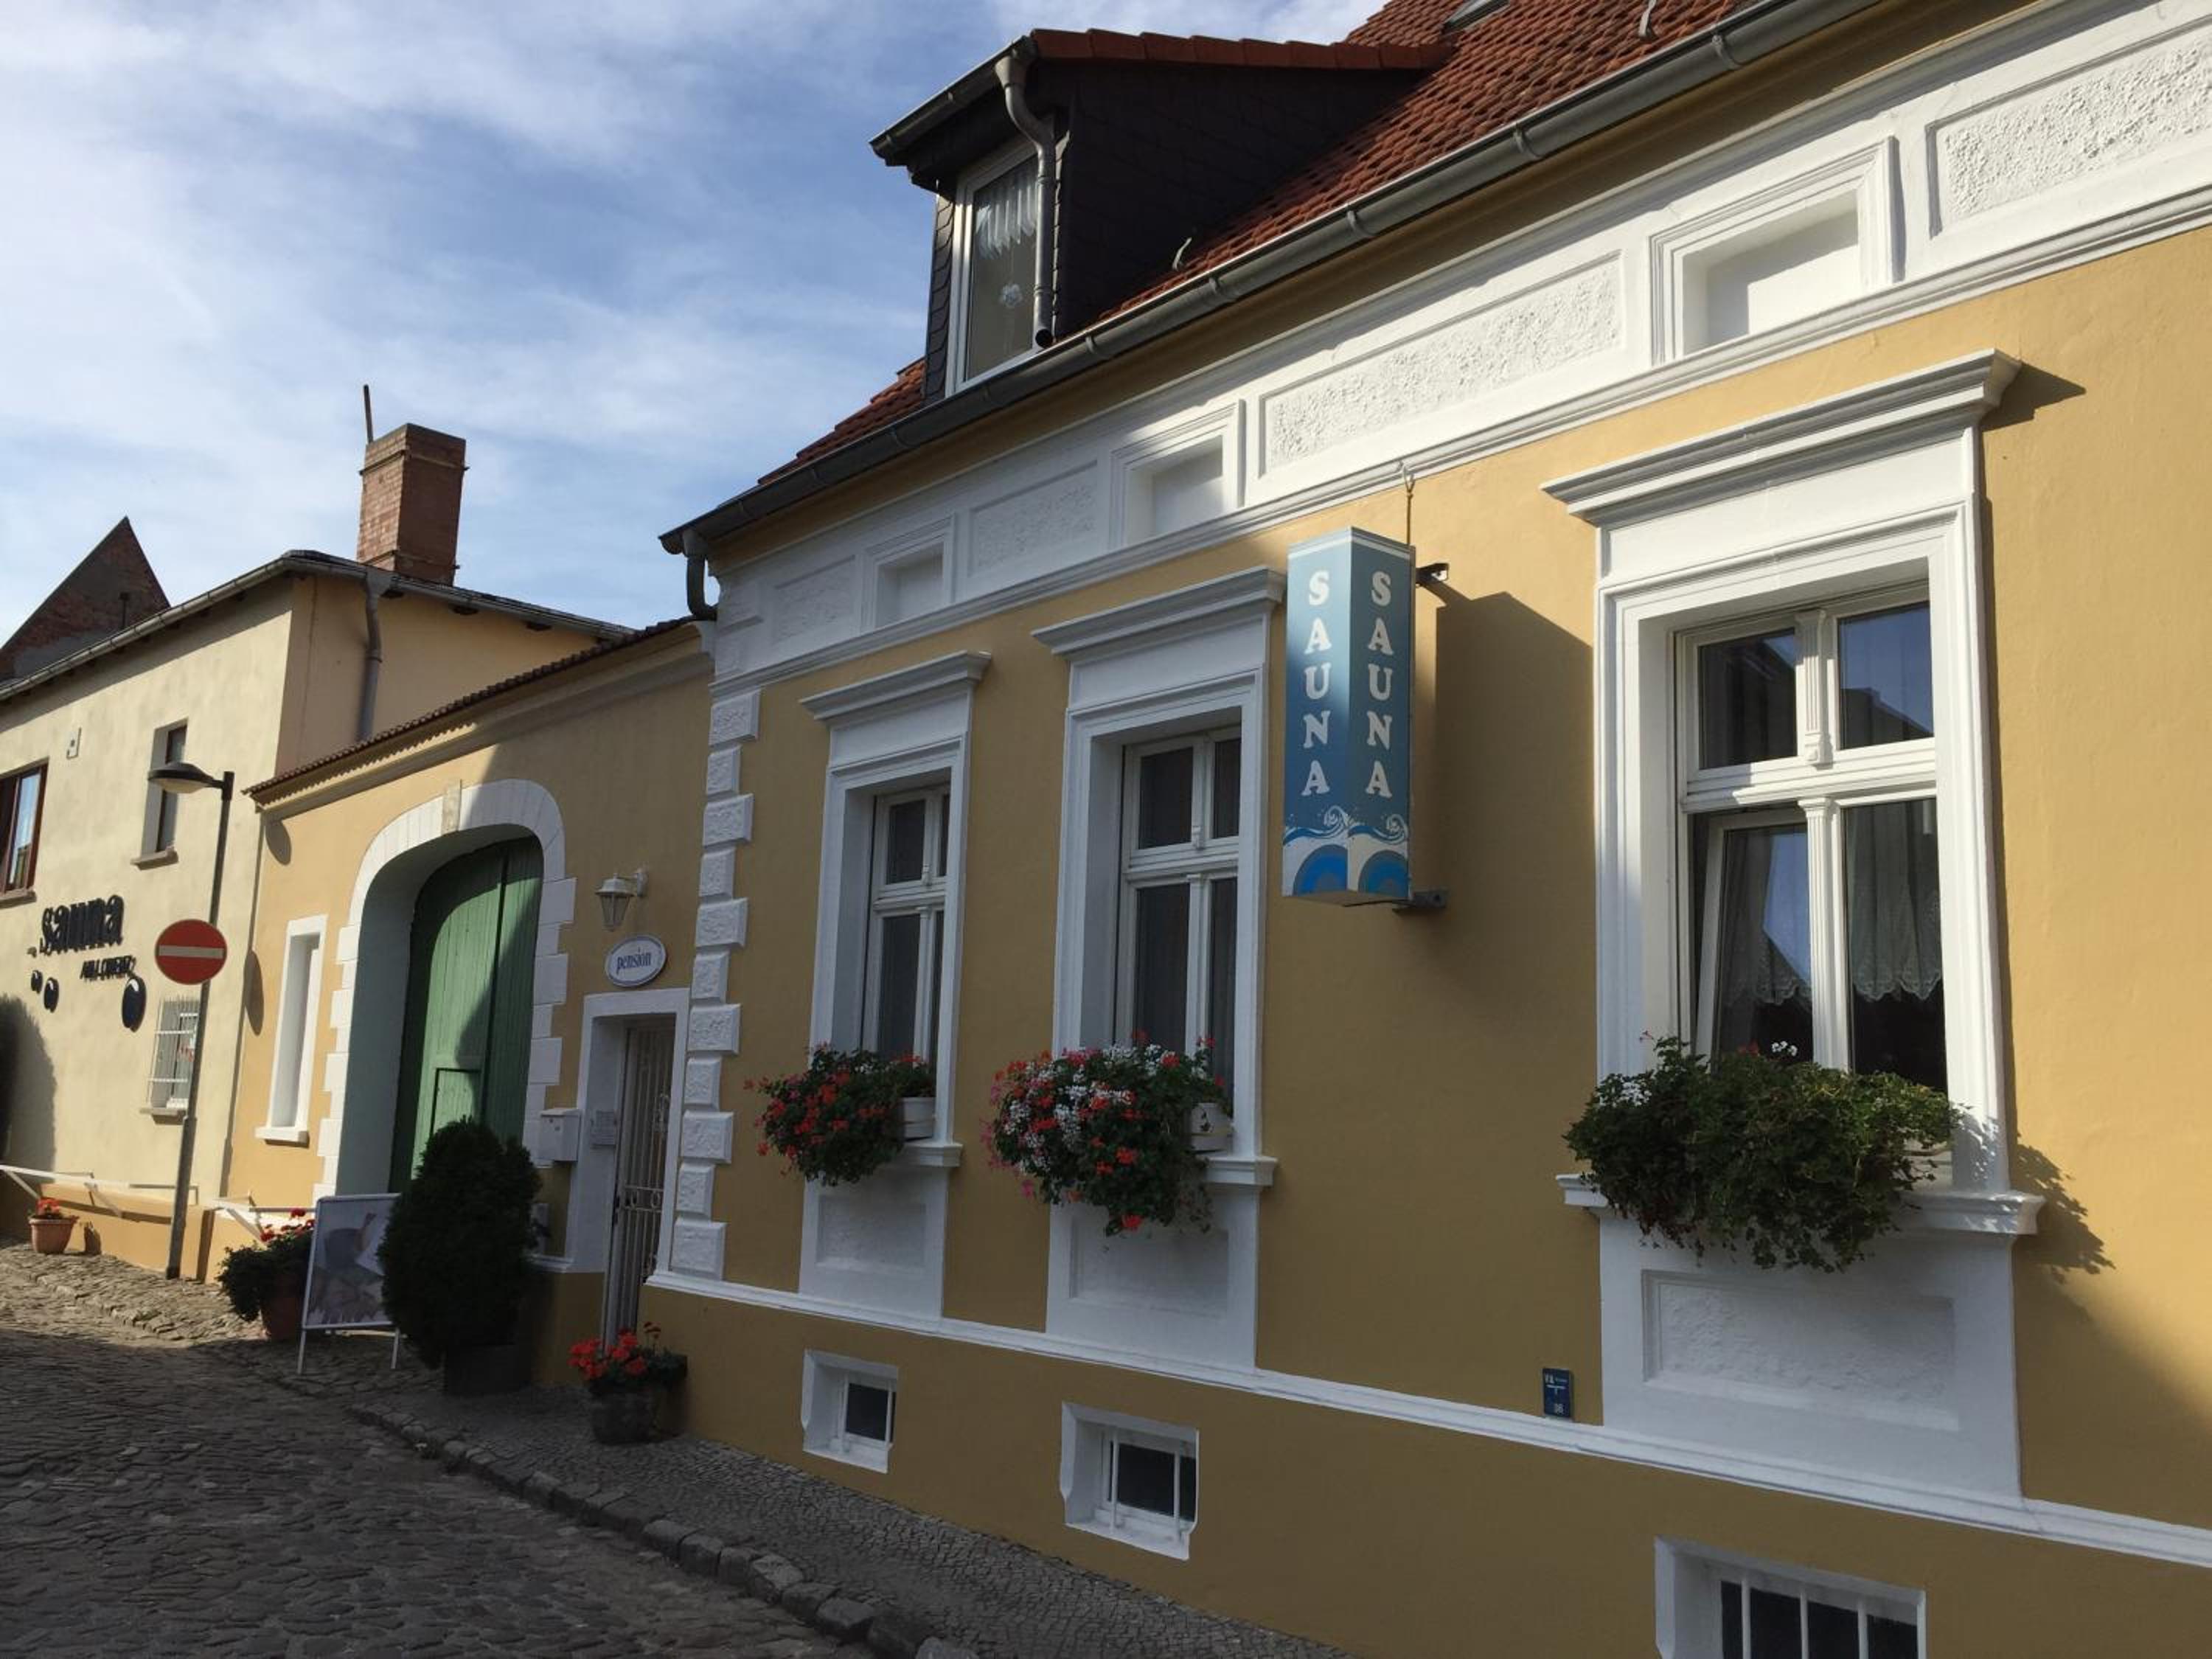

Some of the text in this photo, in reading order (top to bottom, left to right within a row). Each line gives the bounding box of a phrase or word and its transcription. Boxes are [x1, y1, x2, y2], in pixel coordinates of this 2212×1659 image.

[1302, 571, 1332, 796] SAUNA
[1366, 571, 1394, 797] SAUNA
[616, 947, 652, 975] pension
